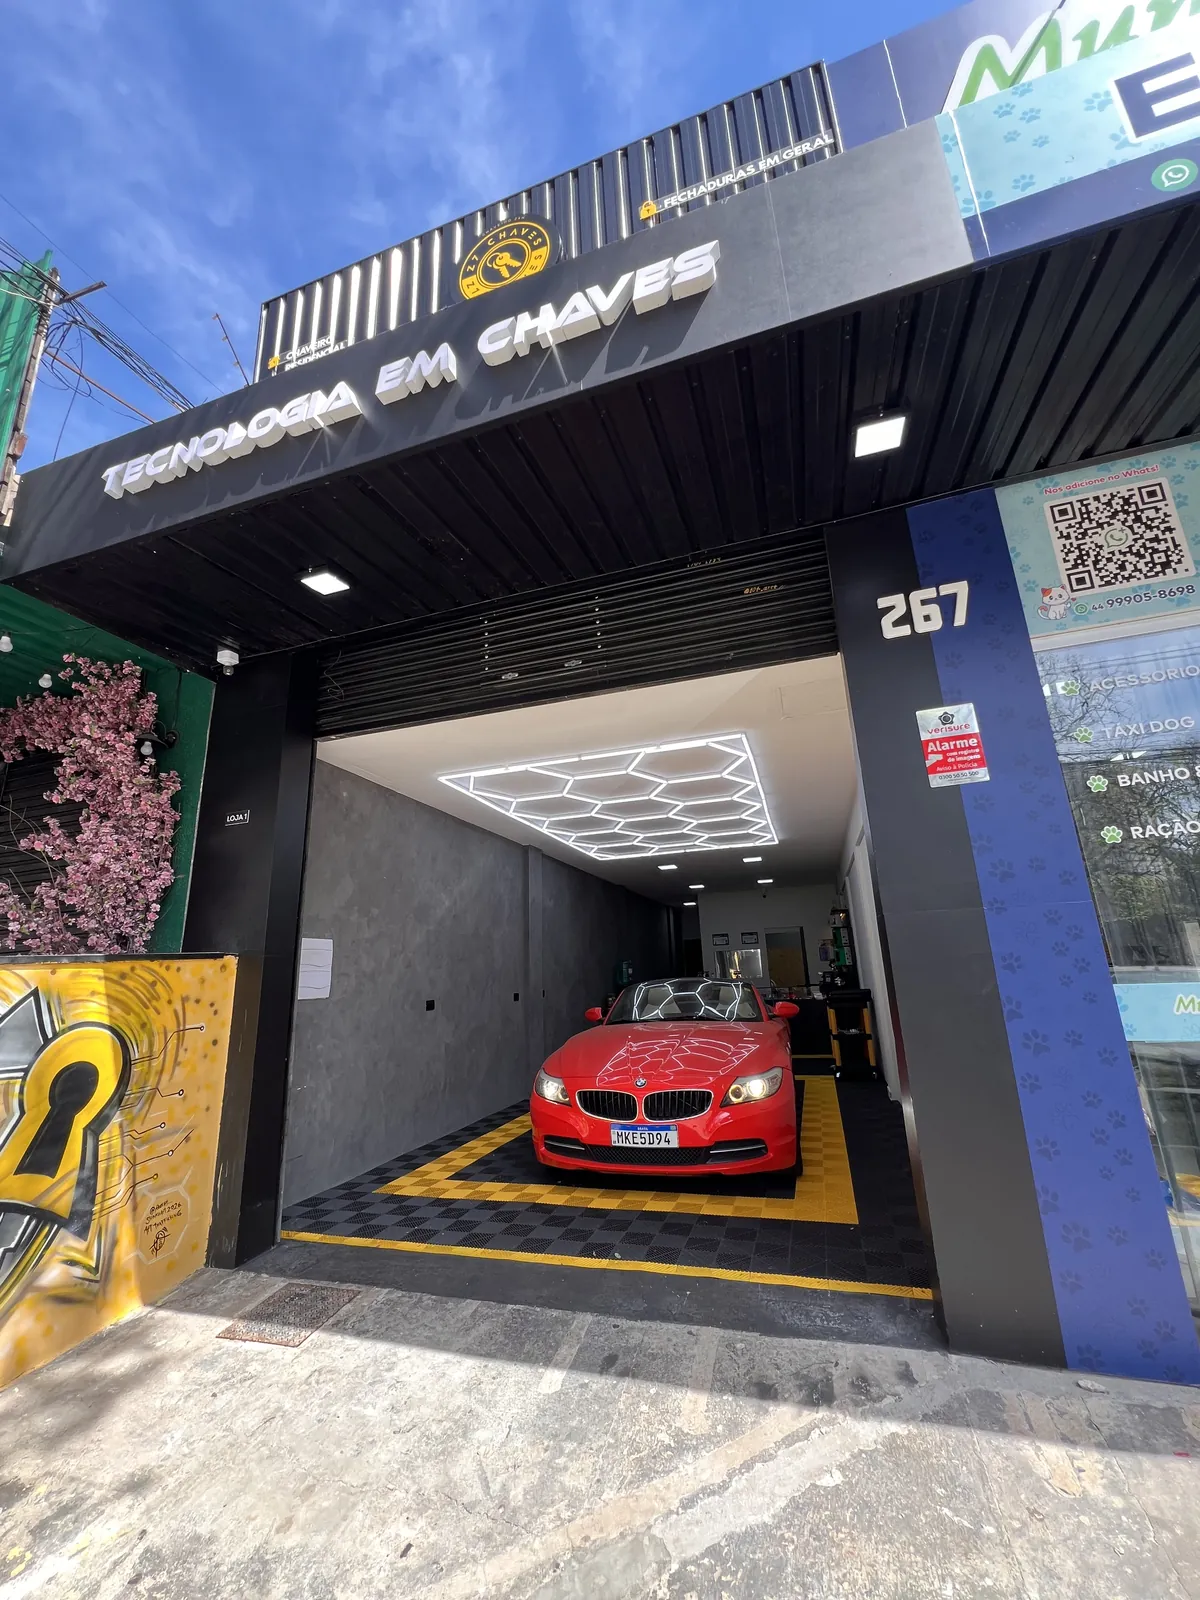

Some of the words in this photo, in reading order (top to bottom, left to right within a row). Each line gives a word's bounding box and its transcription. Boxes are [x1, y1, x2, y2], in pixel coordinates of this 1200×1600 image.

[664, 164, 756, 208] FECHADURAS
[759, 154, 780, 170] EM
[782, 134, 835, 160] GERAL
[487, 227, 542, 246] CHAVES
[285, 342, 346, 371] RESIDENCIAL
[286, 336, 333, 360] CHAVEIRO
[101, 380, 362, 499] TECNOLOGIA
[375, 342, 457, 405] EM
[477, 239, 721, 366] CHAVES
[1044, 487, 1063, 496] Nos
[1065, 477, 1106, 491] adicione
[1108, 473, 1120, 482] no
[1121, 464, 1160, 478] Whats!
[1106, 584, 1196, 608] 99905-8698
[877, 580, 968, 640] 267
[927, 723, 970, 734] verisure
[1101, 721, 1146, 740] TÁXI
[1151, 716, 1195, 734] DOG
[928, 738, 978, 752] Alarme
[958, 748, 980, 756] registro
[955, 754, 981, 762] imagens
[1117, 767, 1190, 787] BANHO
[227, 814, 243, 822] LOJA
[1130, 819, 1200, 839] RAÇÃO
[1174, 994, 1200, 1014] M
[616, 1131, 671, 1145] MKE5D94
